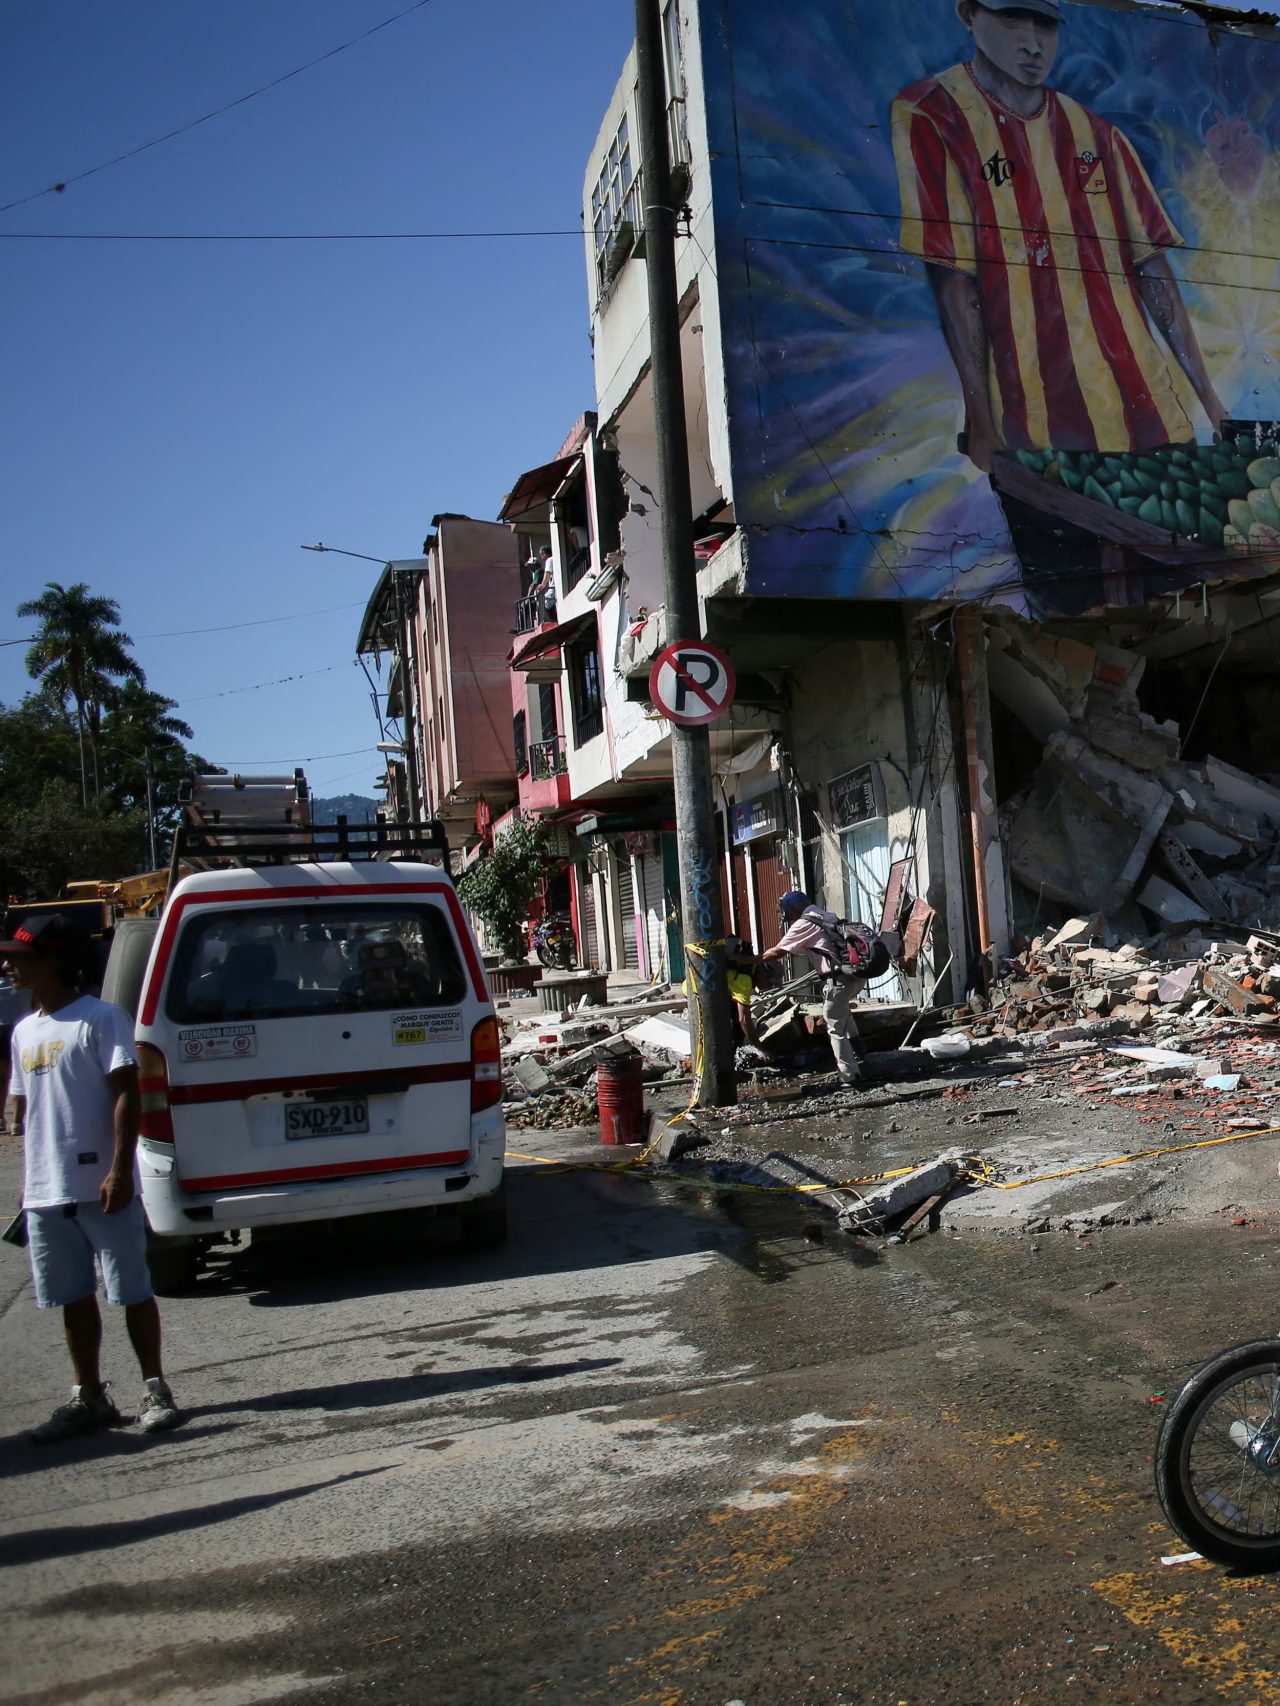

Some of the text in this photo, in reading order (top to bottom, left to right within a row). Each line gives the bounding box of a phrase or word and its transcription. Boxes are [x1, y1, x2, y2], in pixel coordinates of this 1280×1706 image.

[675, 653, 720, 712] P
[400, 1019, 454, 1029] MARQUE GRATIS
[180, 1028, 222, 1040] VELOCIDAD
[398, 1030, 422, 1040] #767
